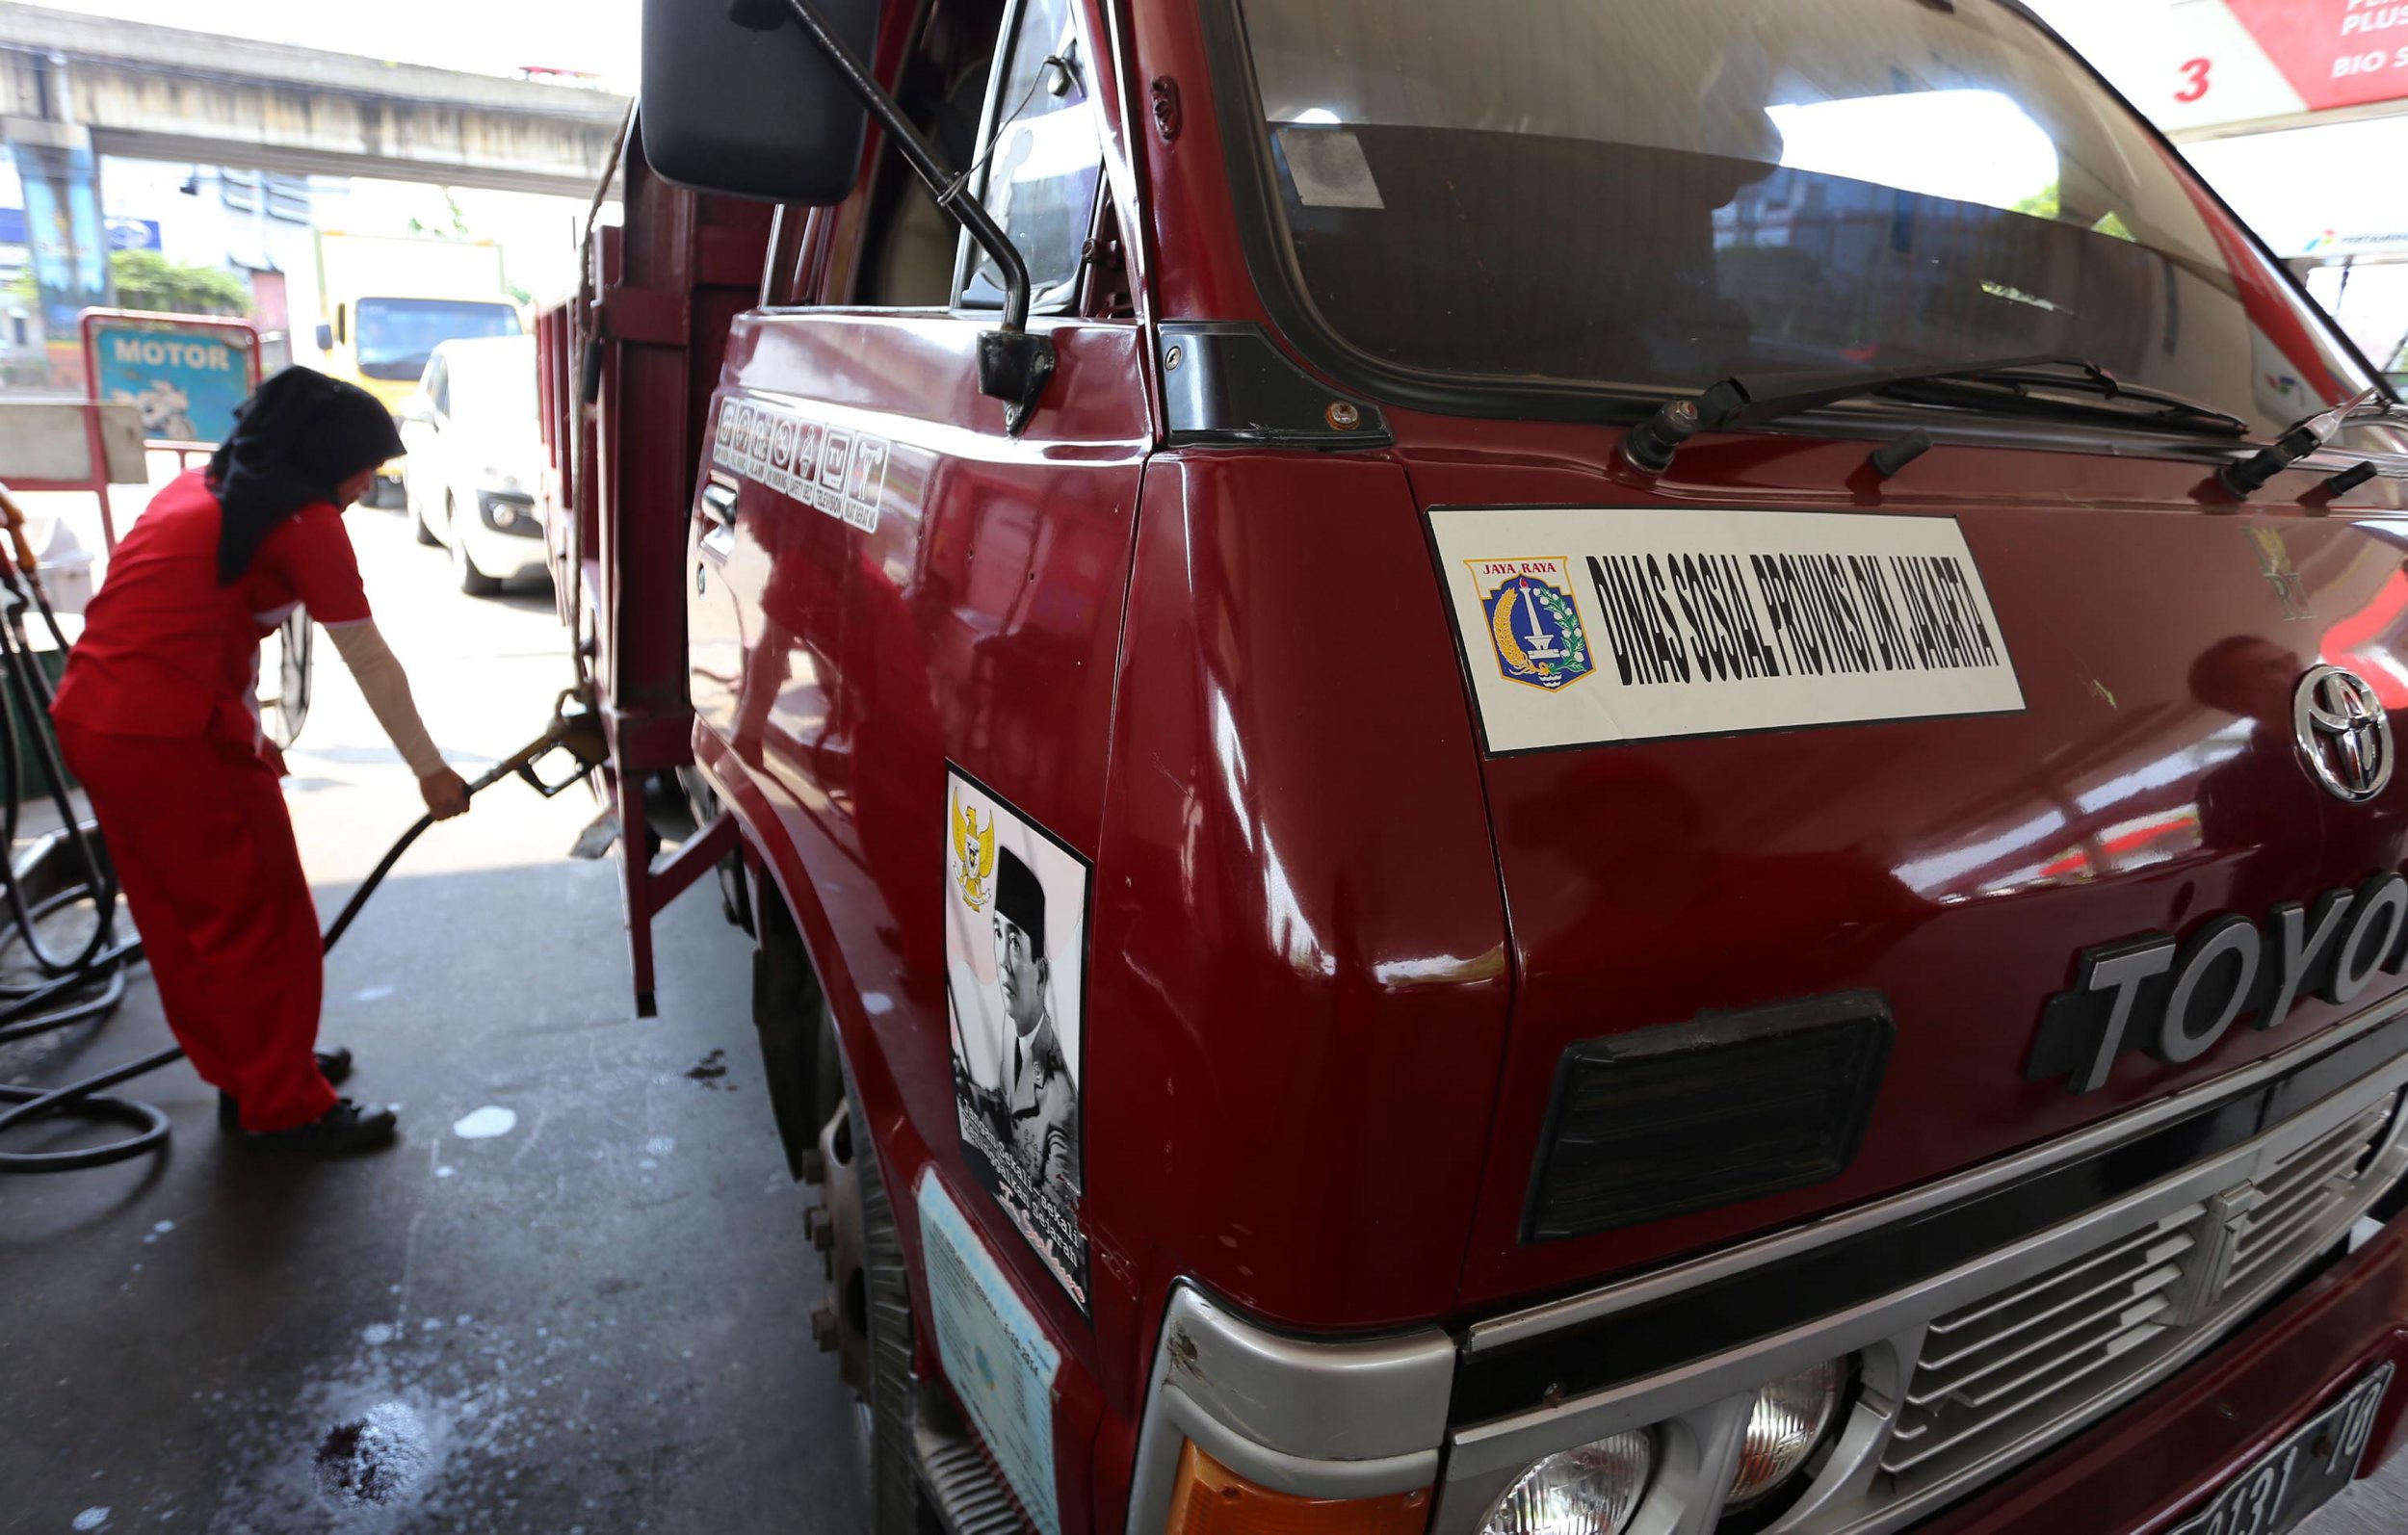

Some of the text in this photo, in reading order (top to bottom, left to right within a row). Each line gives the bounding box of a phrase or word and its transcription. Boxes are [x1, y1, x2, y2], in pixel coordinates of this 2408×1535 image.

[2341, 5, 2408, 36] PLUS
[2174, 58, 2211, 103] 3
[2331, 45, 2408, 78] BIO S
[114, 338, 230, 372] MOTOR
[828, 447, 845, 469] TV
[1482, 561, 1557, 575] JAYA RAYA
[1585, 553, 2000, 686] DINAS SOSIAL PROVINSI DKI JAKARTA
[2083, 873, 2408, 1093] TOYO
[963, 1099, 998, 1149] Jangan
[1032, 1201, 1078, 1268] Sejarah
